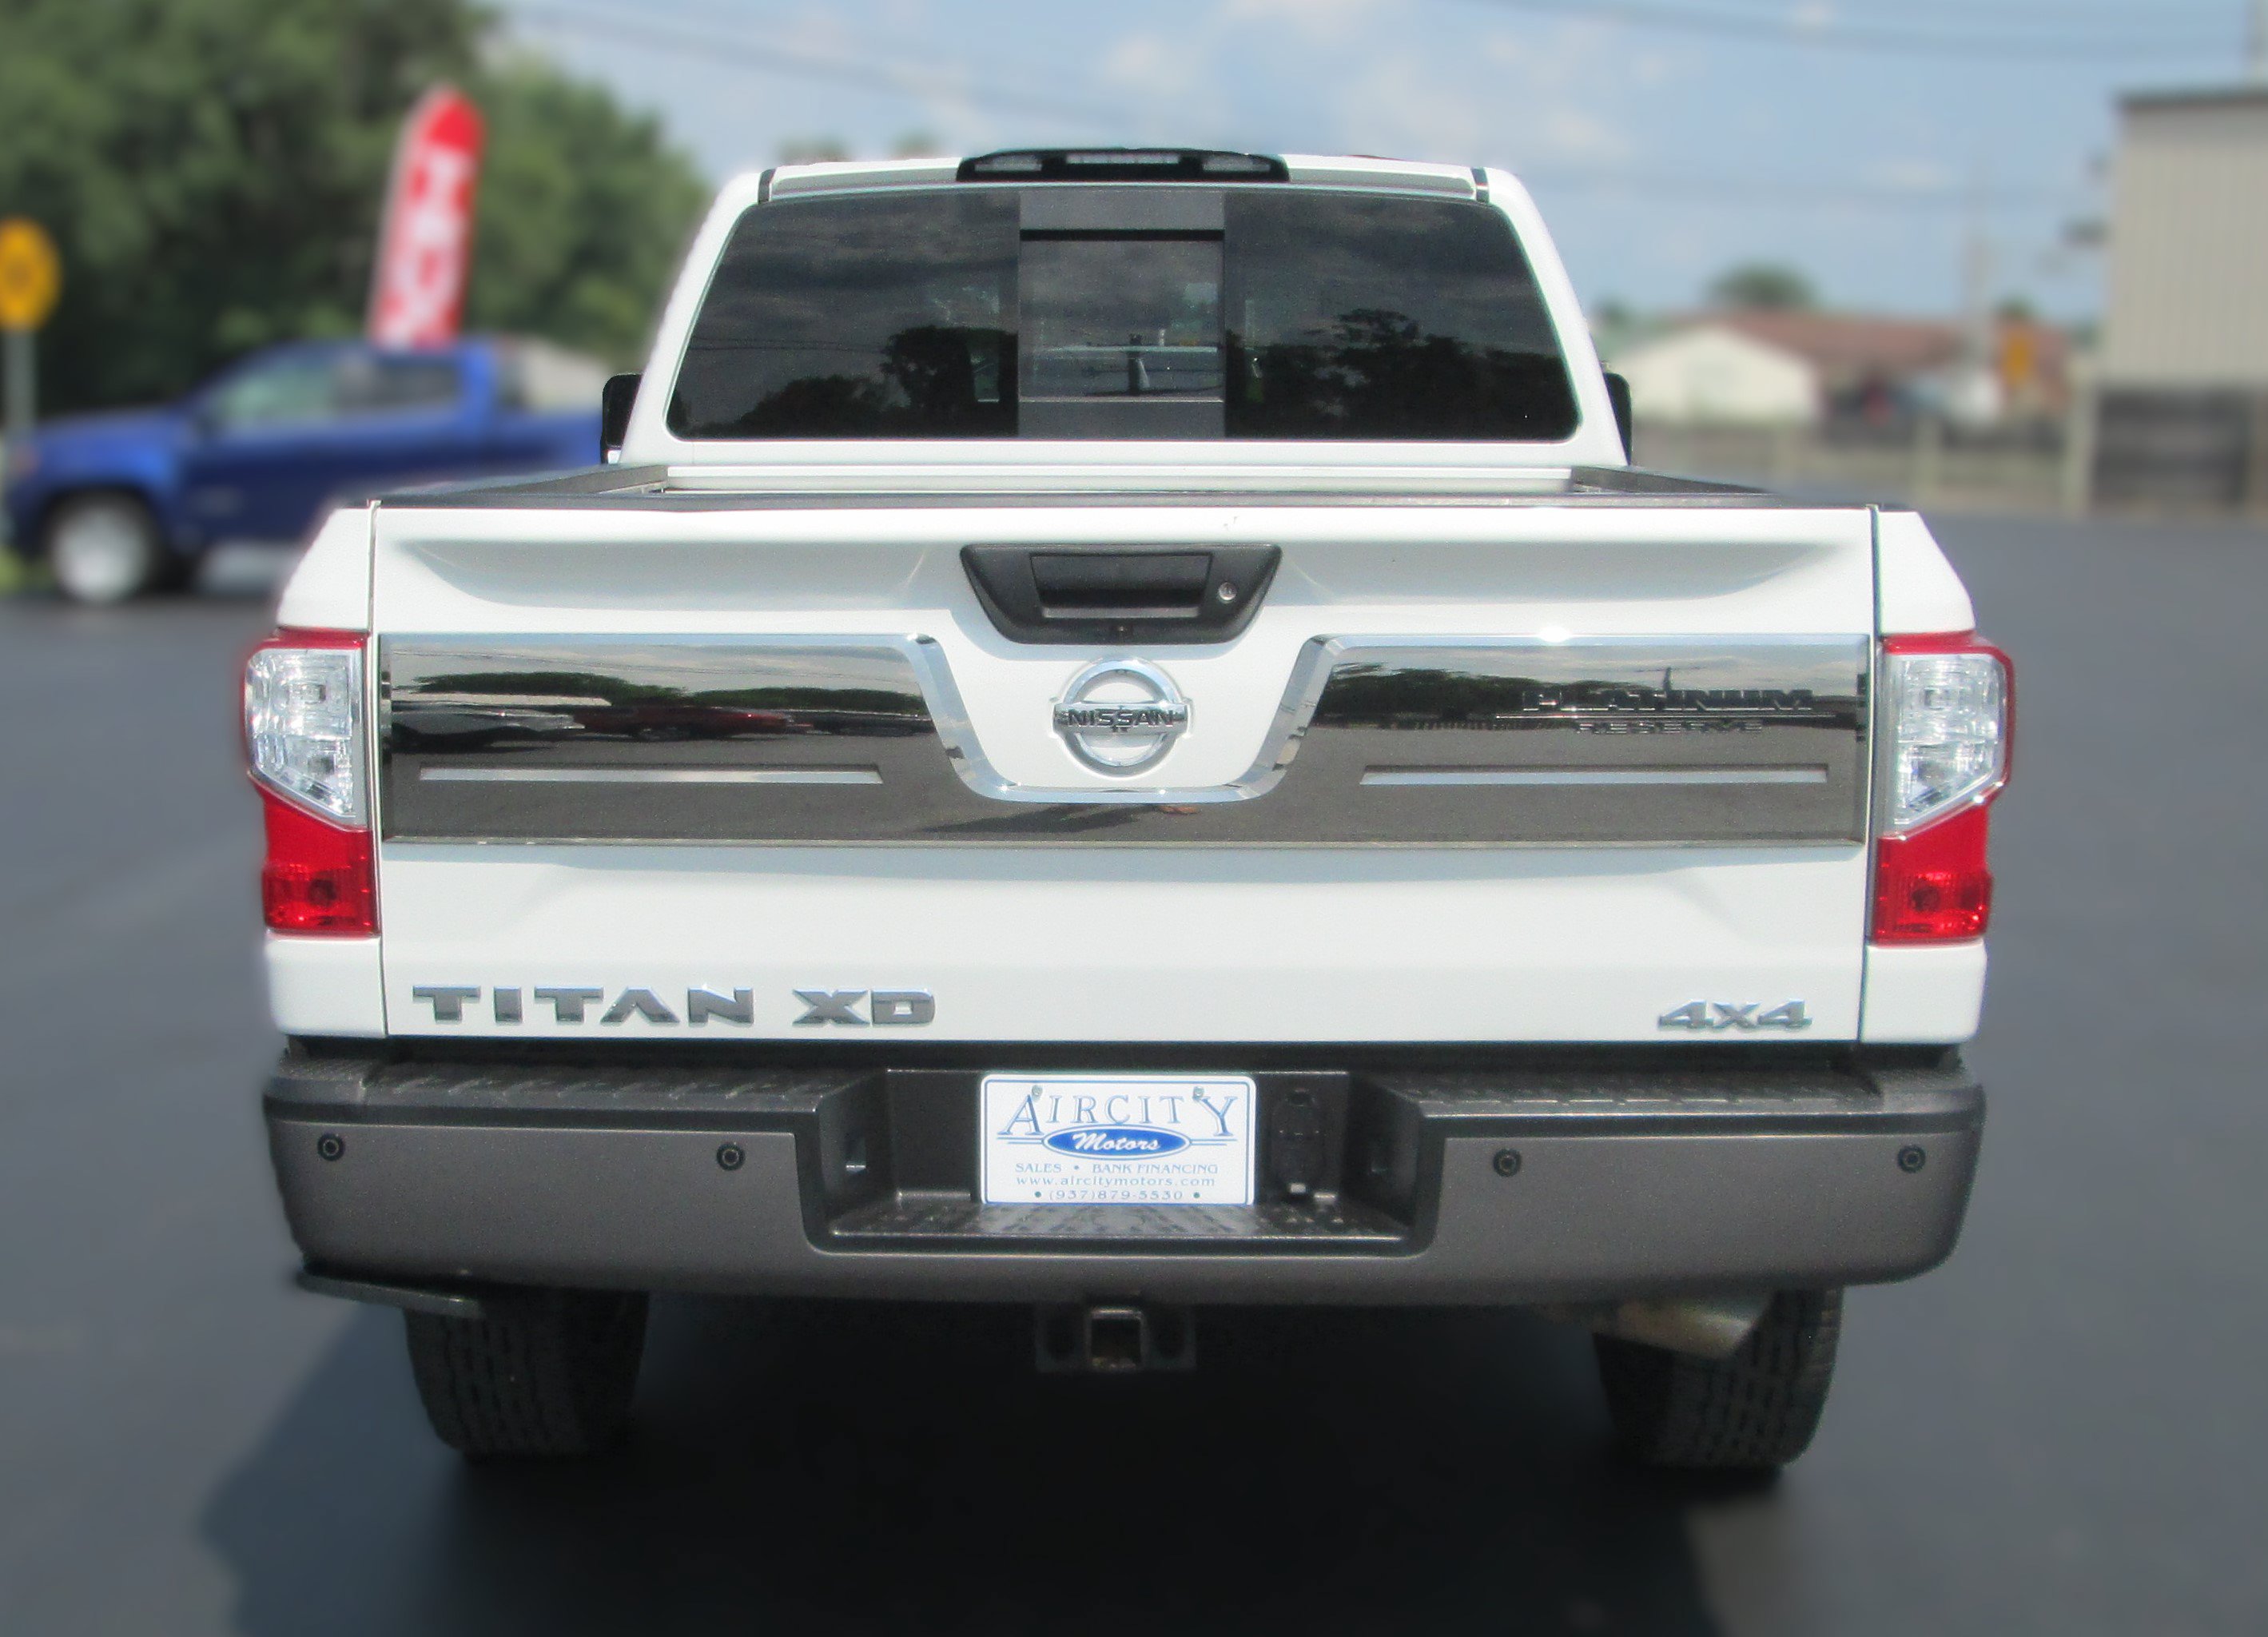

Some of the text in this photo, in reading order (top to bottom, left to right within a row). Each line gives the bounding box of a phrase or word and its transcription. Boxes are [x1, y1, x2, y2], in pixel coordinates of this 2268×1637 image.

[1068, 708, 1174, 727] NISSAN
[412, 985, 936, 1026] TITAN XD
[998, 1093, 1238, 1137] AIRCITY
[1072, 1132, 1160, 1151] Motors
[1014, 1163, 1218, 1174] SALES BANK FINANCING
[1016, 1175, 1216, 1187] www.aircitymotors.com
